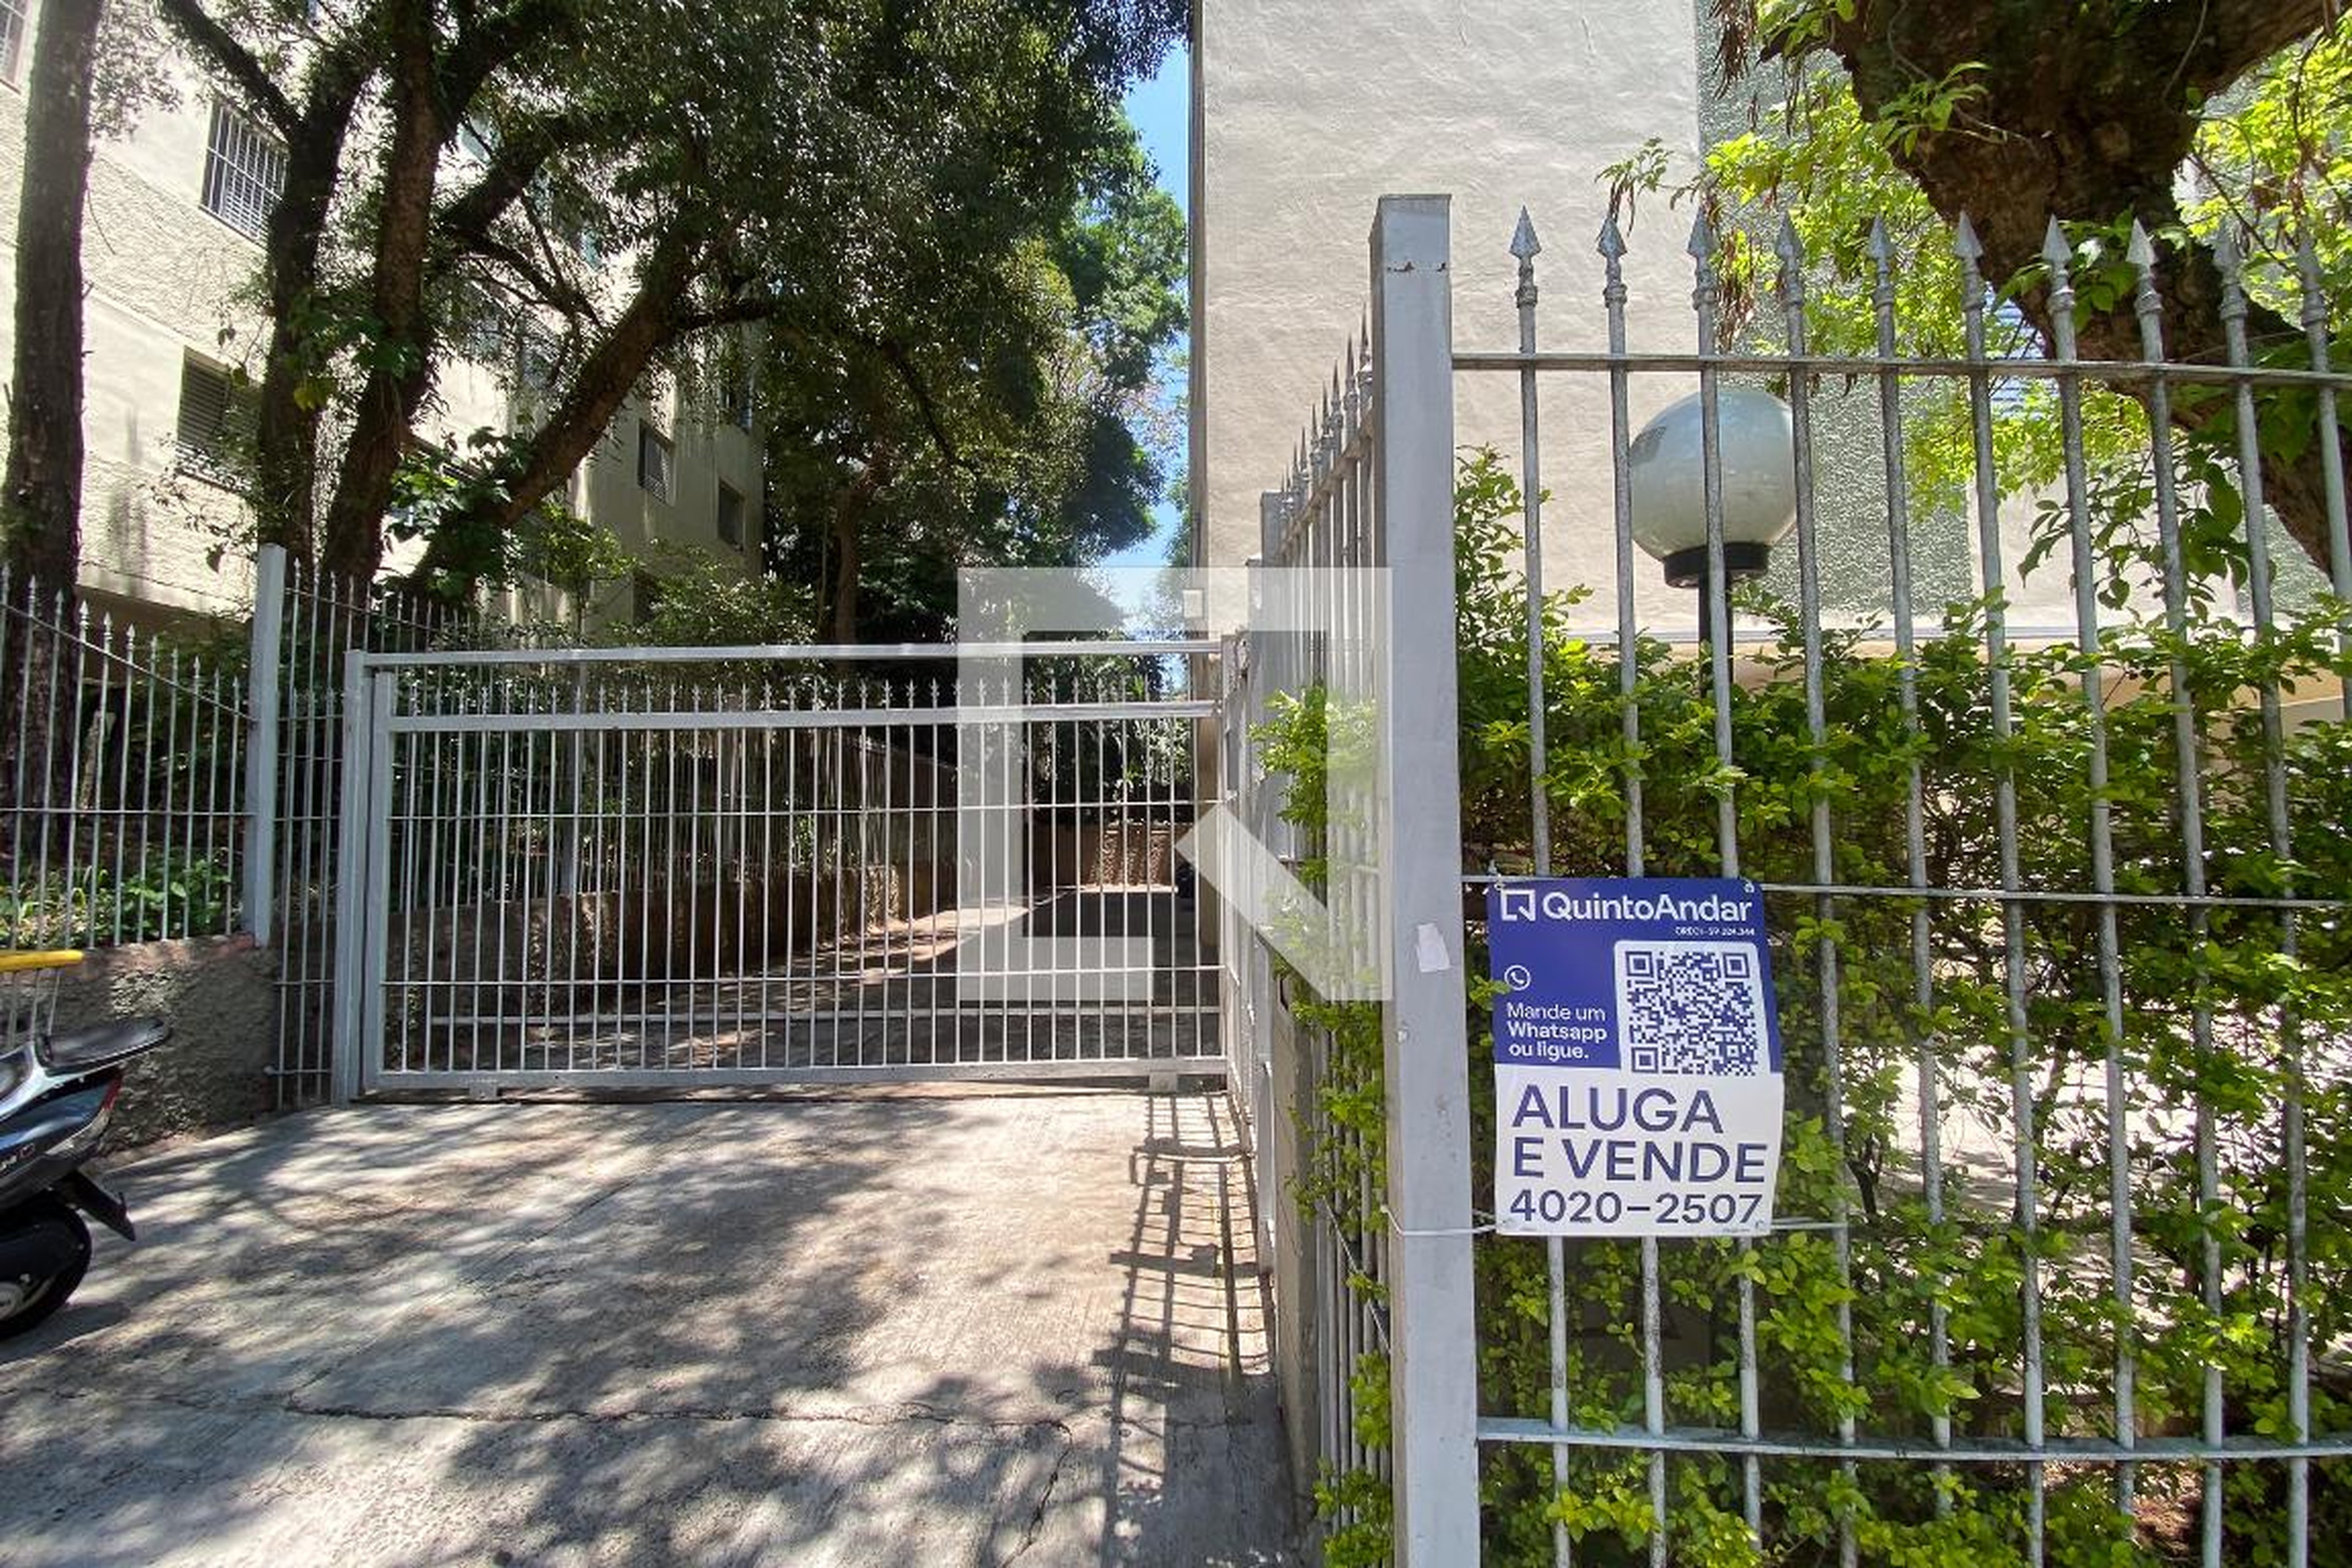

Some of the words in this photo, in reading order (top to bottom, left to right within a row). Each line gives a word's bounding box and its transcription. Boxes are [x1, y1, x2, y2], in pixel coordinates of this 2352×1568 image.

[1542, 892, 1752, 922] QuintoAndar
[1507, 1002, 1571, 1020] Mande
[1575, 1008, 1606, 1022] um
[1507, 1020, 1607, 1043] Whatsapp
[1509, 1043, 1532, 1057] ou
[1537, 1041, 1589, 1062] ligue.
[1512, 1084, 1724, 1134] ALUGA
[1513, 1136, 1545, 1178] E
[1561, 1138, 1768, 1183] VENDE
[1510, 1189, 1763, 1224] 4020-2507
